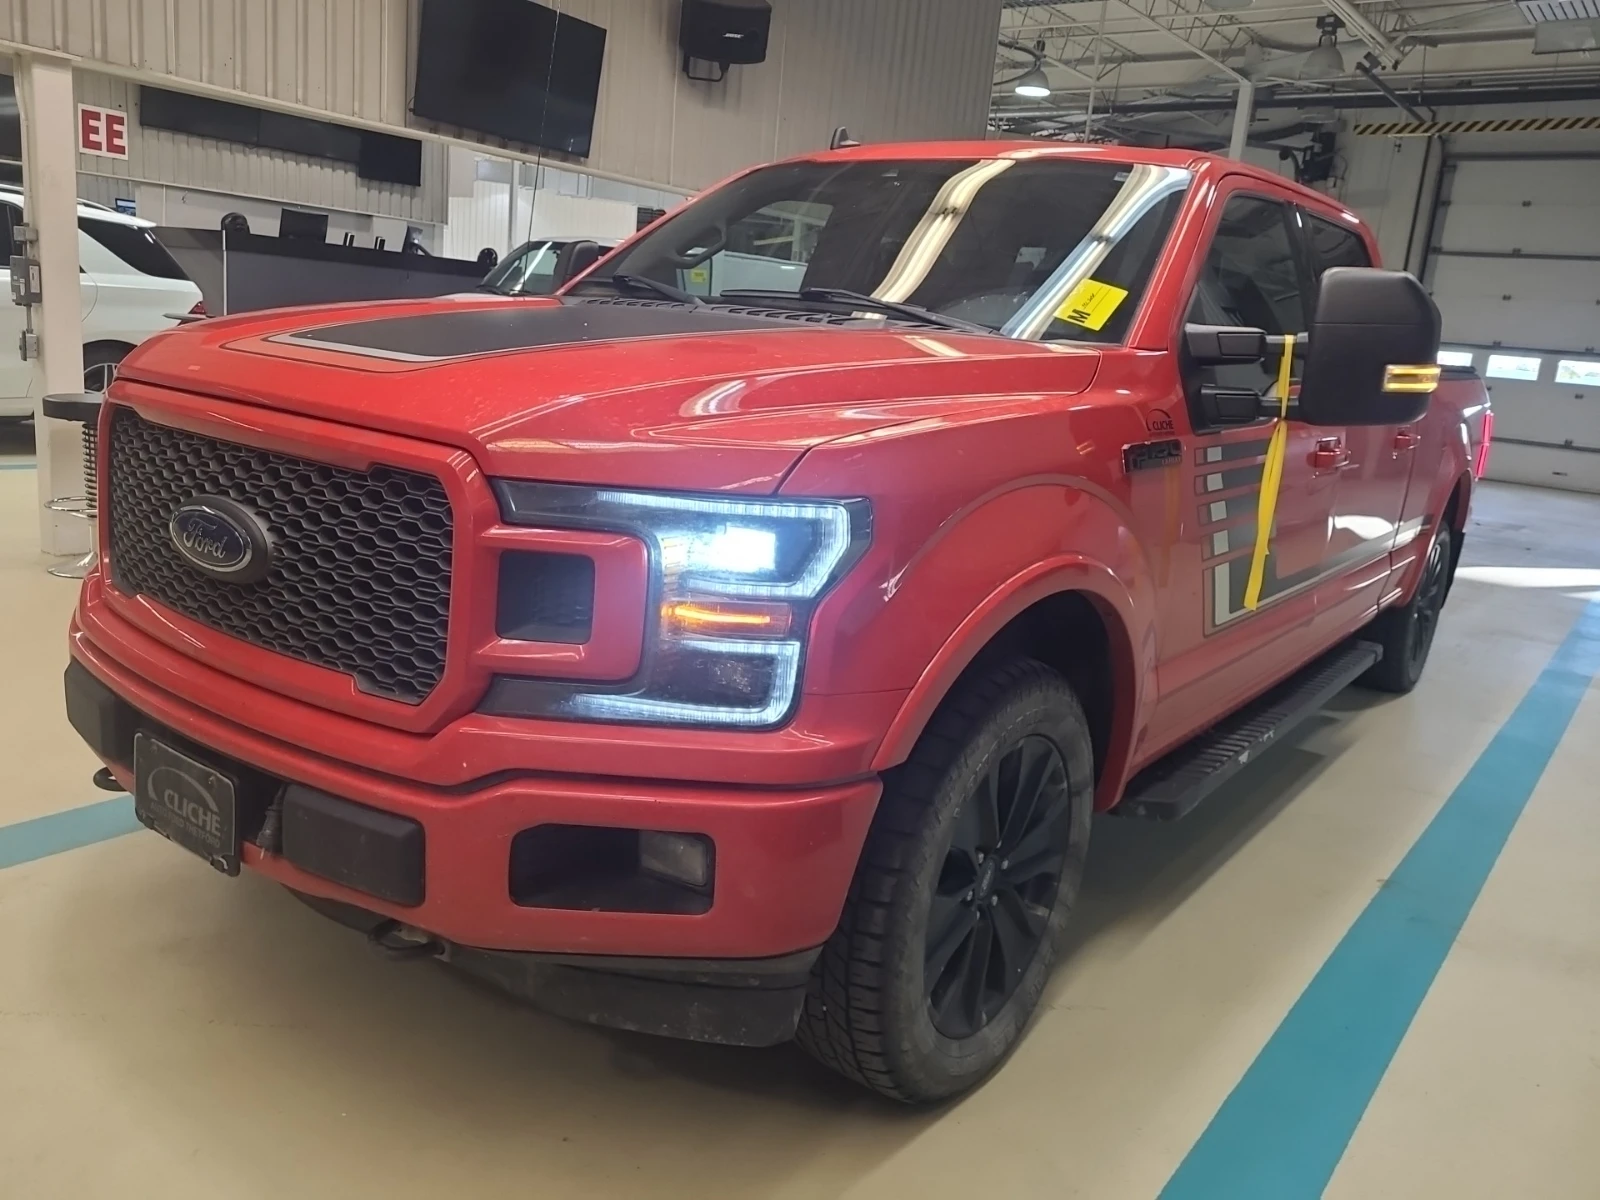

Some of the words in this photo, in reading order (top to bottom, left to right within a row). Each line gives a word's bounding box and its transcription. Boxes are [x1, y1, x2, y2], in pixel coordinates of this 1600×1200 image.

[81, 109, 126, 155] EE
[1066, 308, 1091, 324] M
[183, 517, 227, 558] Ford
[164, 789, 221, 837] CLICHE
